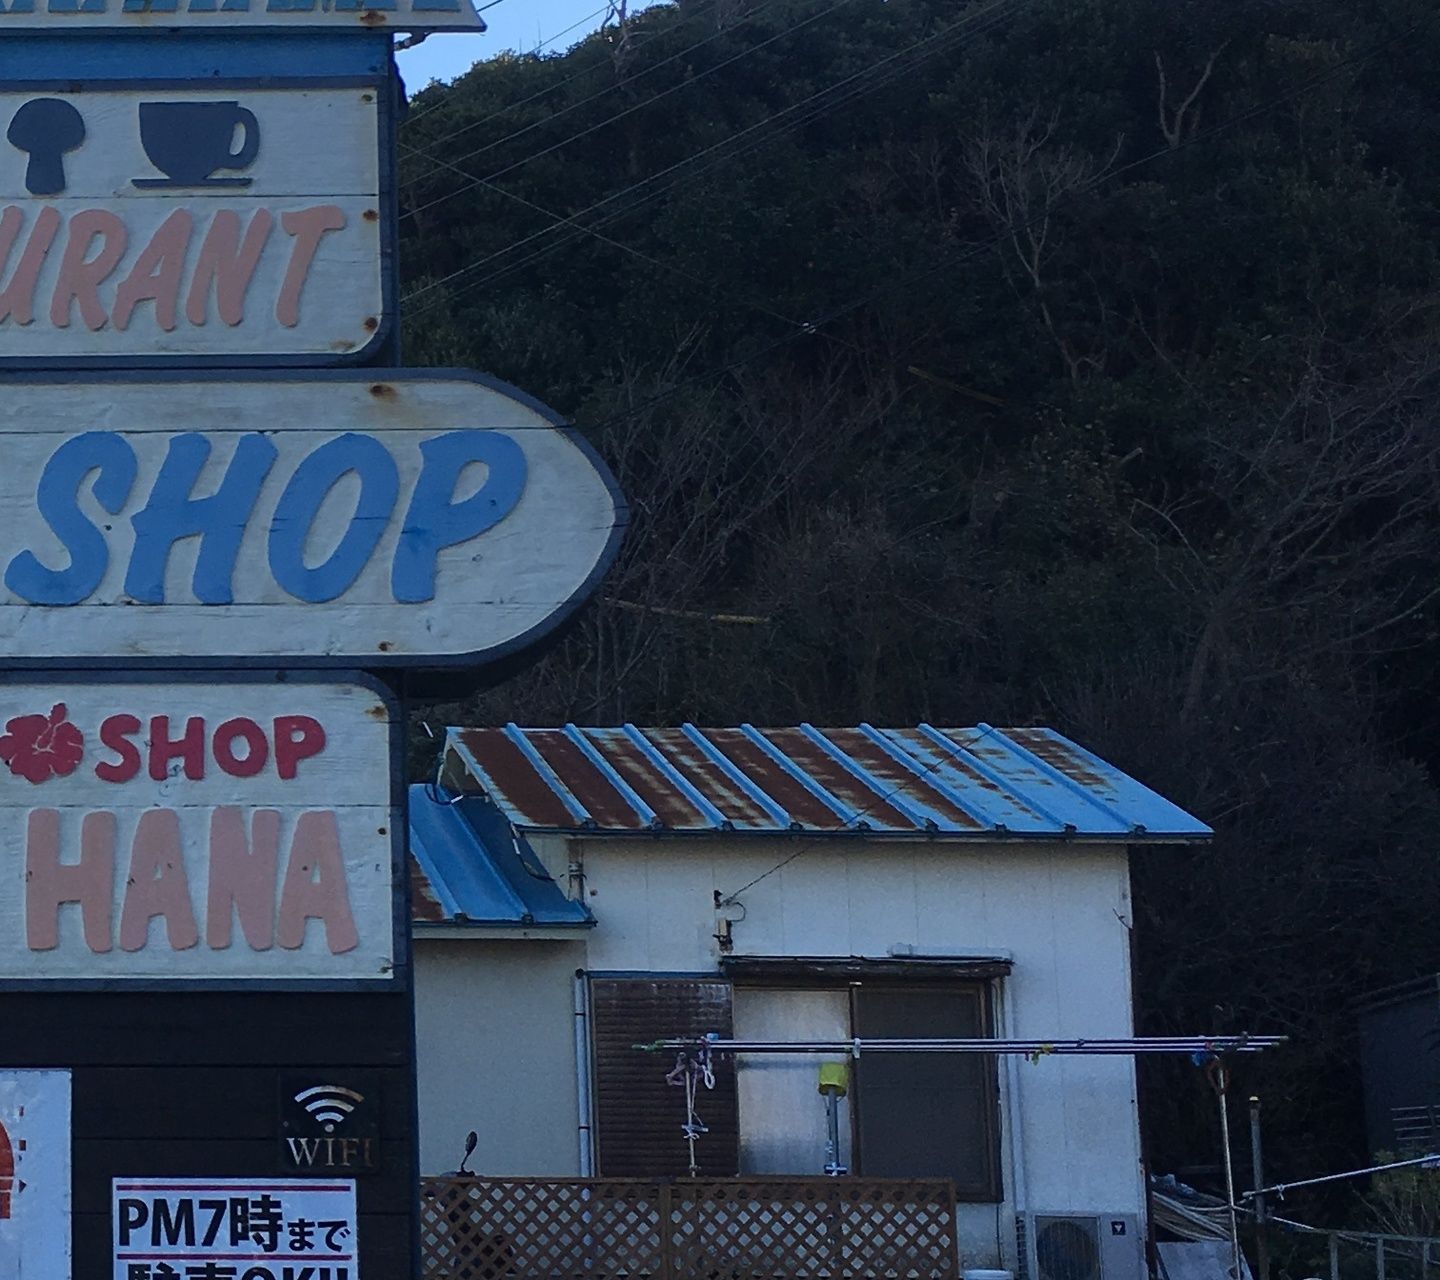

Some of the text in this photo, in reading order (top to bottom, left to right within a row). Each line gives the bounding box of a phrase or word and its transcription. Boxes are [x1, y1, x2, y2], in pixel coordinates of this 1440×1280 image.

[5, 430, 527, 606] SHOP
[97, 715, 327, 781] SHOP
[26, 807, 359, 954] HANA
[286, 1137, 374, 1167] WIFI
[118, 1194, 351, 1252] PM7時まで
